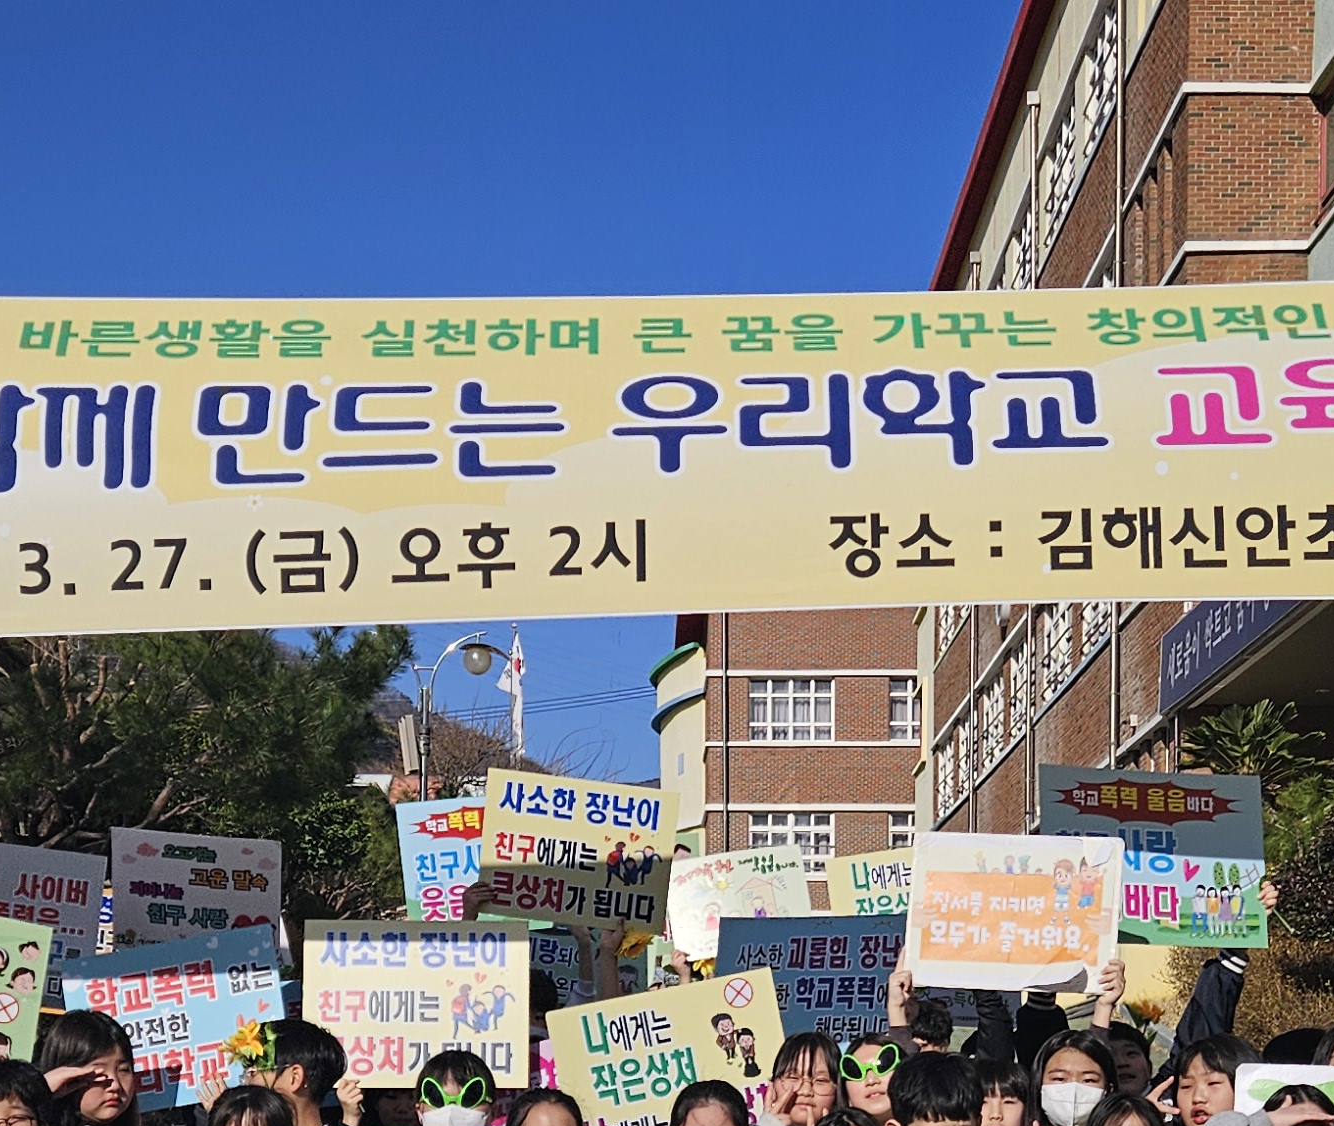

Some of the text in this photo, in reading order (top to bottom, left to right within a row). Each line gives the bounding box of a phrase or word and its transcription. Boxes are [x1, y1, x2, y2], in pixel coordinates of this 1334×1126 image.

[19, 319, 331, 359] 바른생활을
[362, 317, 600, 358] 실천하며
[634, 316, 692, 354] 큰
[721, 314, 843, 353] 꿈을
[872, 310, 1057, 349] 가꾸는
[1088, 304, 1330, 345] 창의적인
[195, 380, 566, 485] 만드는
[611, 368, 1111, 470] 우리학교
[390, 521, 516, 590] 오후
[548, 518, 647, 583] 2시
[828, 510, 956, 578] 장소
[499, 780, 661, 831] 사소한 장난이
[1072, 784, 1138, 810] 학교폭력
[426, 810, 481, 832] 학교폭력
[492, 830, 599, 873] 친구에게는
[14, 873, 90, 907] 사이버
[188, 868, 228, 889] 고운
[851, 861, 911, 891] 나에게는
[146, 903, 229, 929] 친구 사랑
[593, 889, 656, 924] 됩니다
[931, 888, 983, 917] 질서를
[989, 891, 1047, 915] 지키면
[319, 931, 412, 968] 사소한
[419, 930, 507, 970] 장난이
[736, 935, 852, 971] 사소한 괴롭힘,
[928, 919, 1091, 953] 모두가 즐거워요.
[85, 958, 273, 1018] 학교폭력 없는
[317, 988, 441, 1025] 친구에게는
[581, 1009, 672, 1056] 나에게는
